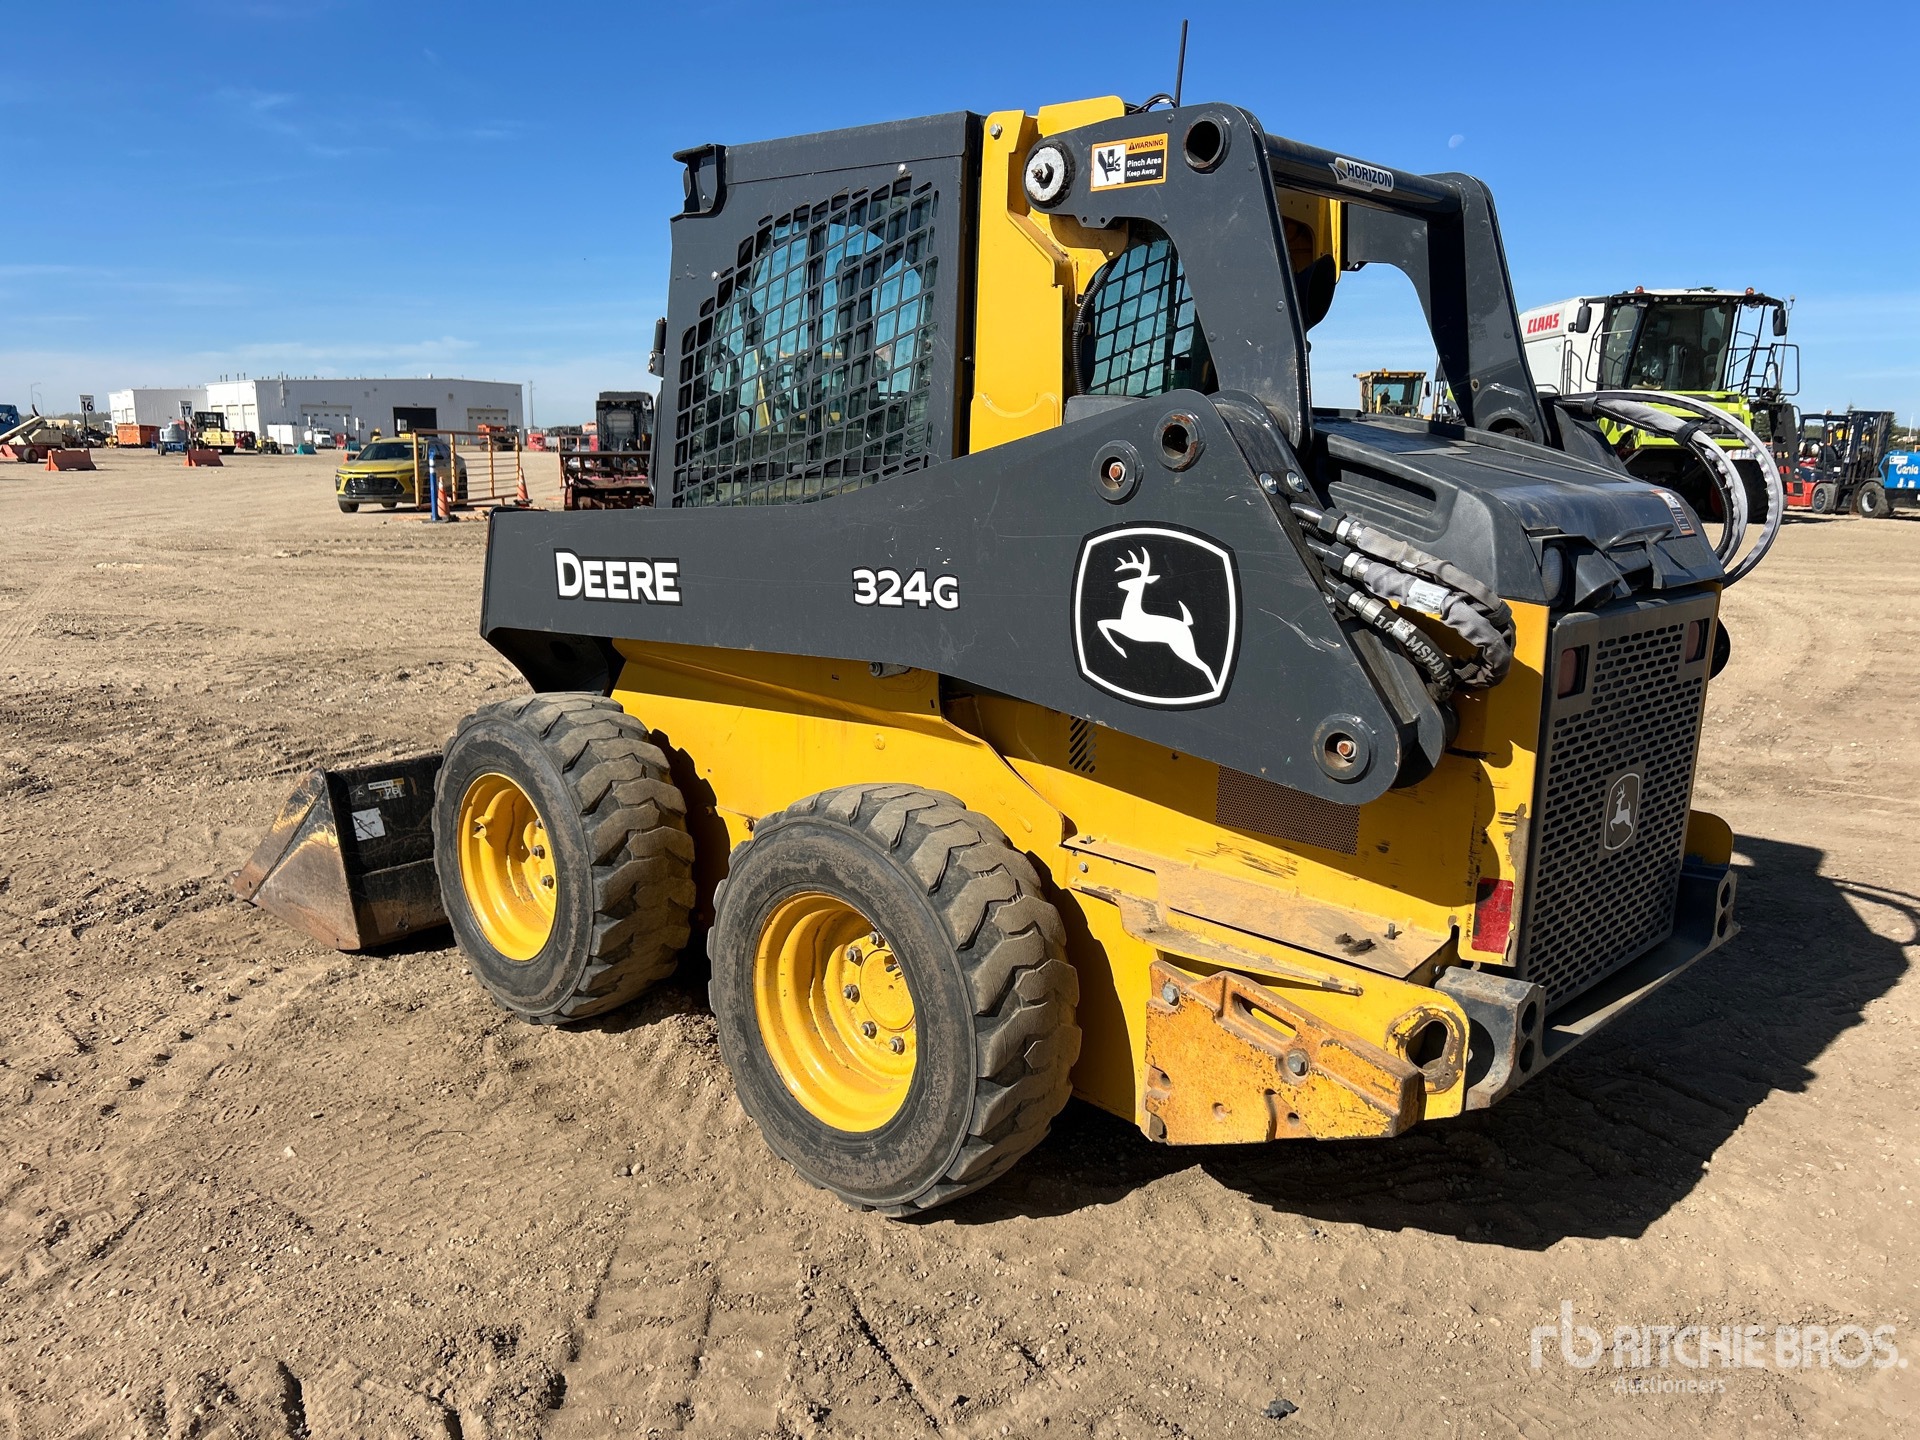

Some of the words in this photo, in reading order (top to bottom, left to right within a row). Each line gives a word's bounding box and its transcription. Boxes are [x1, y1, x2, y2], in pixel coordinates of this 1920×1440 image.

[1135, 139, 1164, 149] WARNING
[1127, 159, 1145, 168] Pinch
[1146, 157, 1162, 165] Area
[1126, 169, 1140, 177] Keep
[1141, 168, 1157, 176] Away
[1346, 162, 1393, 188] HORIZON
[1527, 312, 1560, 334] CLAAS
[81, 401, 94, 412] 16
[181, 406, 192, 416] 17
[555, 551, 681, 602] DEERE
[852, 569, 959, 610] 324G
[1406, 635, 1445, 675] MSHA
